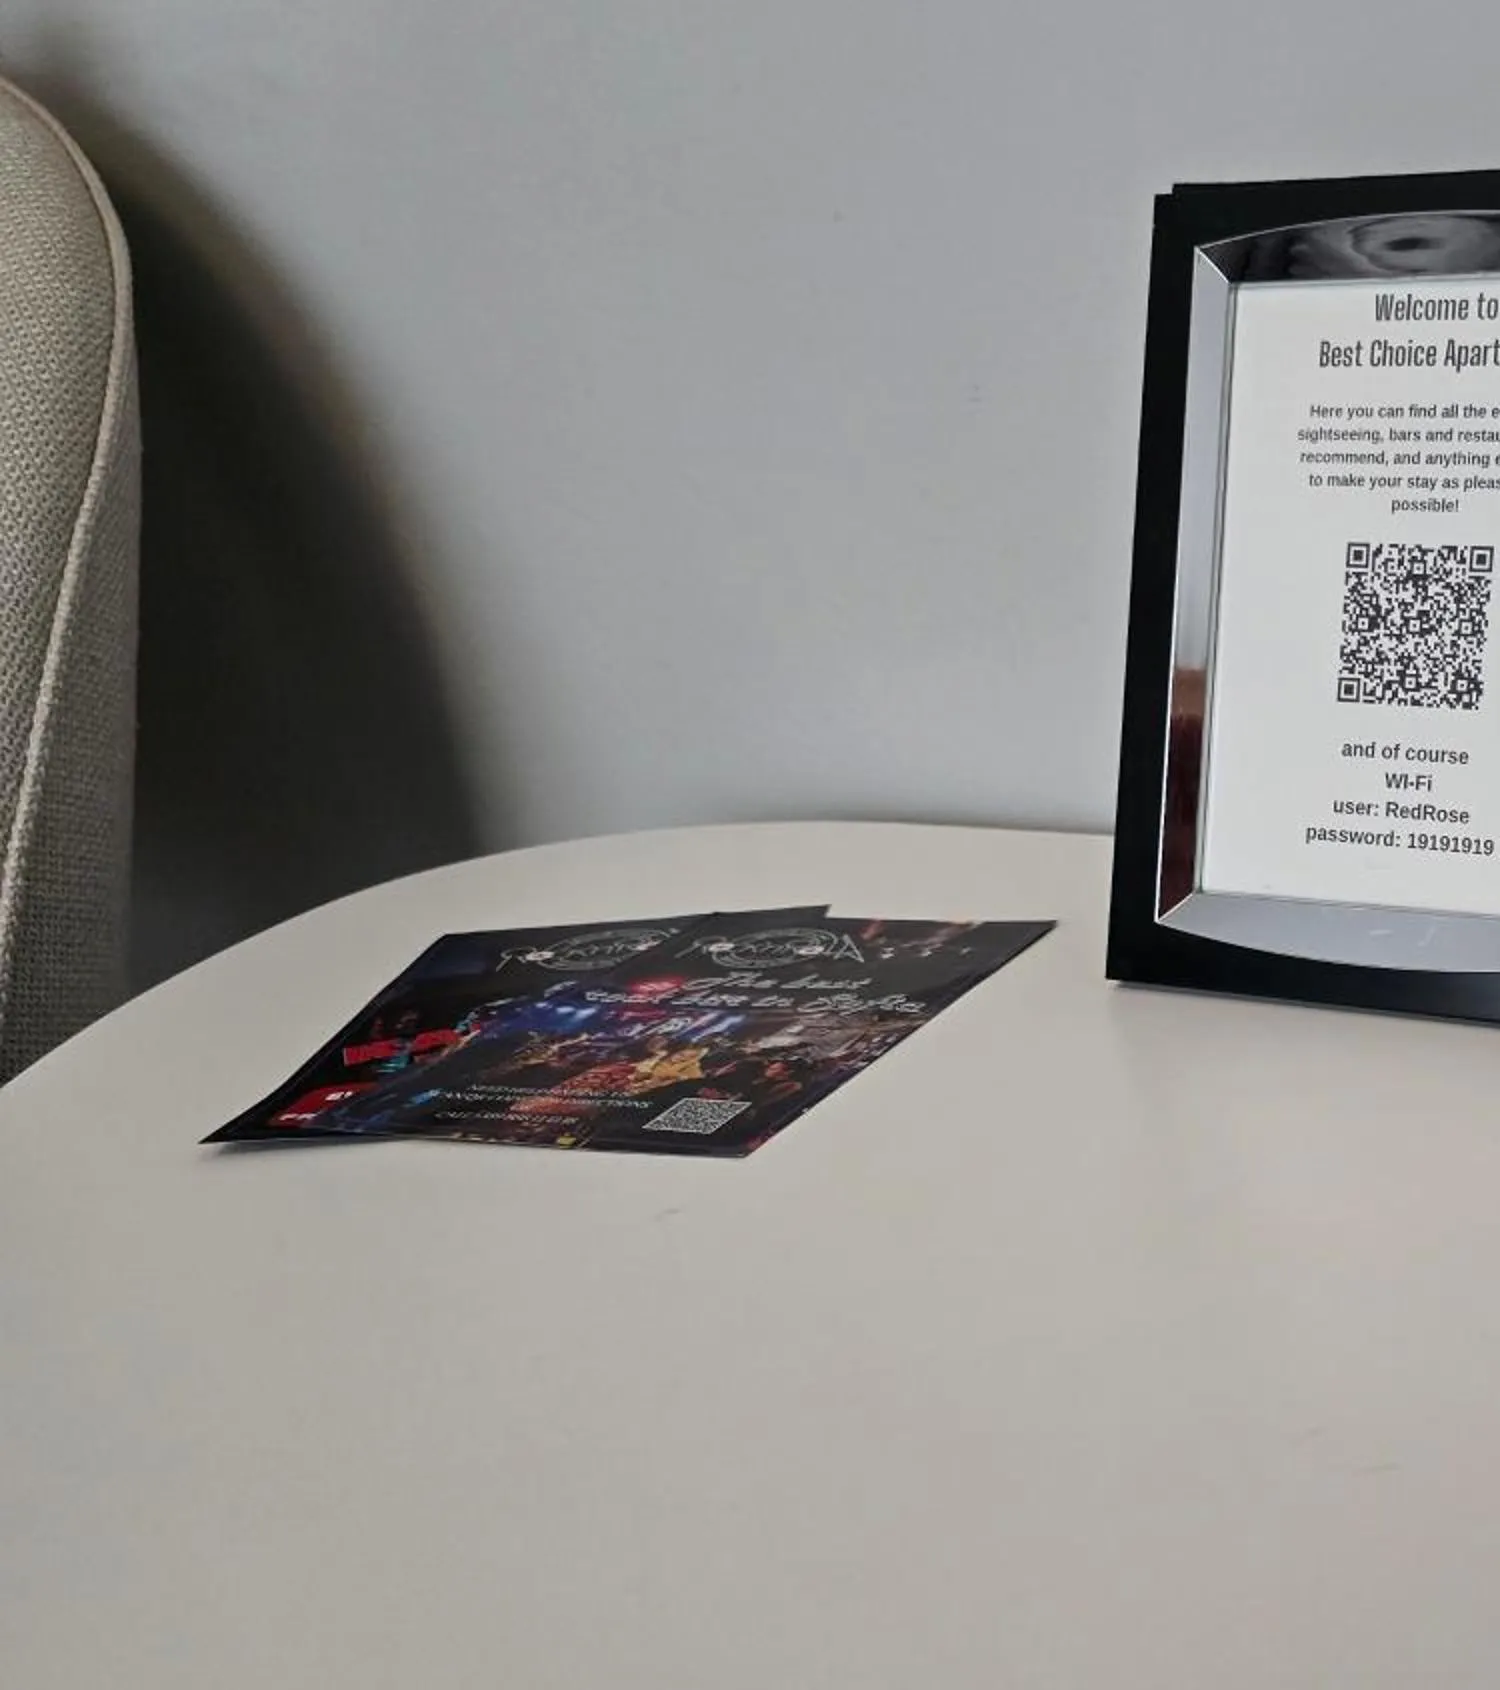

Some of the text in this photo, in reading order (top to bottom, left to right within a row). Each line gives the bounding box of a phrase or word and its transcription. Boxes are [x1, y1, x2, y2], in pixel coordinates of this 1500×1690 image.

[1375, 291, 1499, 322] Welcome to
[1318, 339, 1364, 369] Best
[1369, 338, 1438, 368] Choice
[1309, 404, 1344, 419] Here
[1347, 406, 1375, 421] you
[1377, 406, 1405, 419] can
[1407, 403, 1438, 419] find
[1440, 403, 1459, 419] all
[1462, 403, 1488, 419] the
[1297, 426, 1385, 445] sightseeing,
[1388, 427, 1422, 442] bars
[1425, 427, 1454, 443] and
[1299, 449, 1389, 467] recommend,
[1393, 450, 1422, 465] and
[1424, 451, 1491, 470] anything
[1308, 473, 1324, 487] to
[1326, 472, 1366, 488] make
[1368, 475, 1403, 491] your
[1406, 475, 1439, 493] stay
[1441, 477, 1460, 490] as
[1391, 497, 1460, 515] possible!
[1340, 741, 1470, 765] and of course
[1333, 799, 1471, 825] user: RedRose
[1305, 827, 1495, 857] password: 19191919
